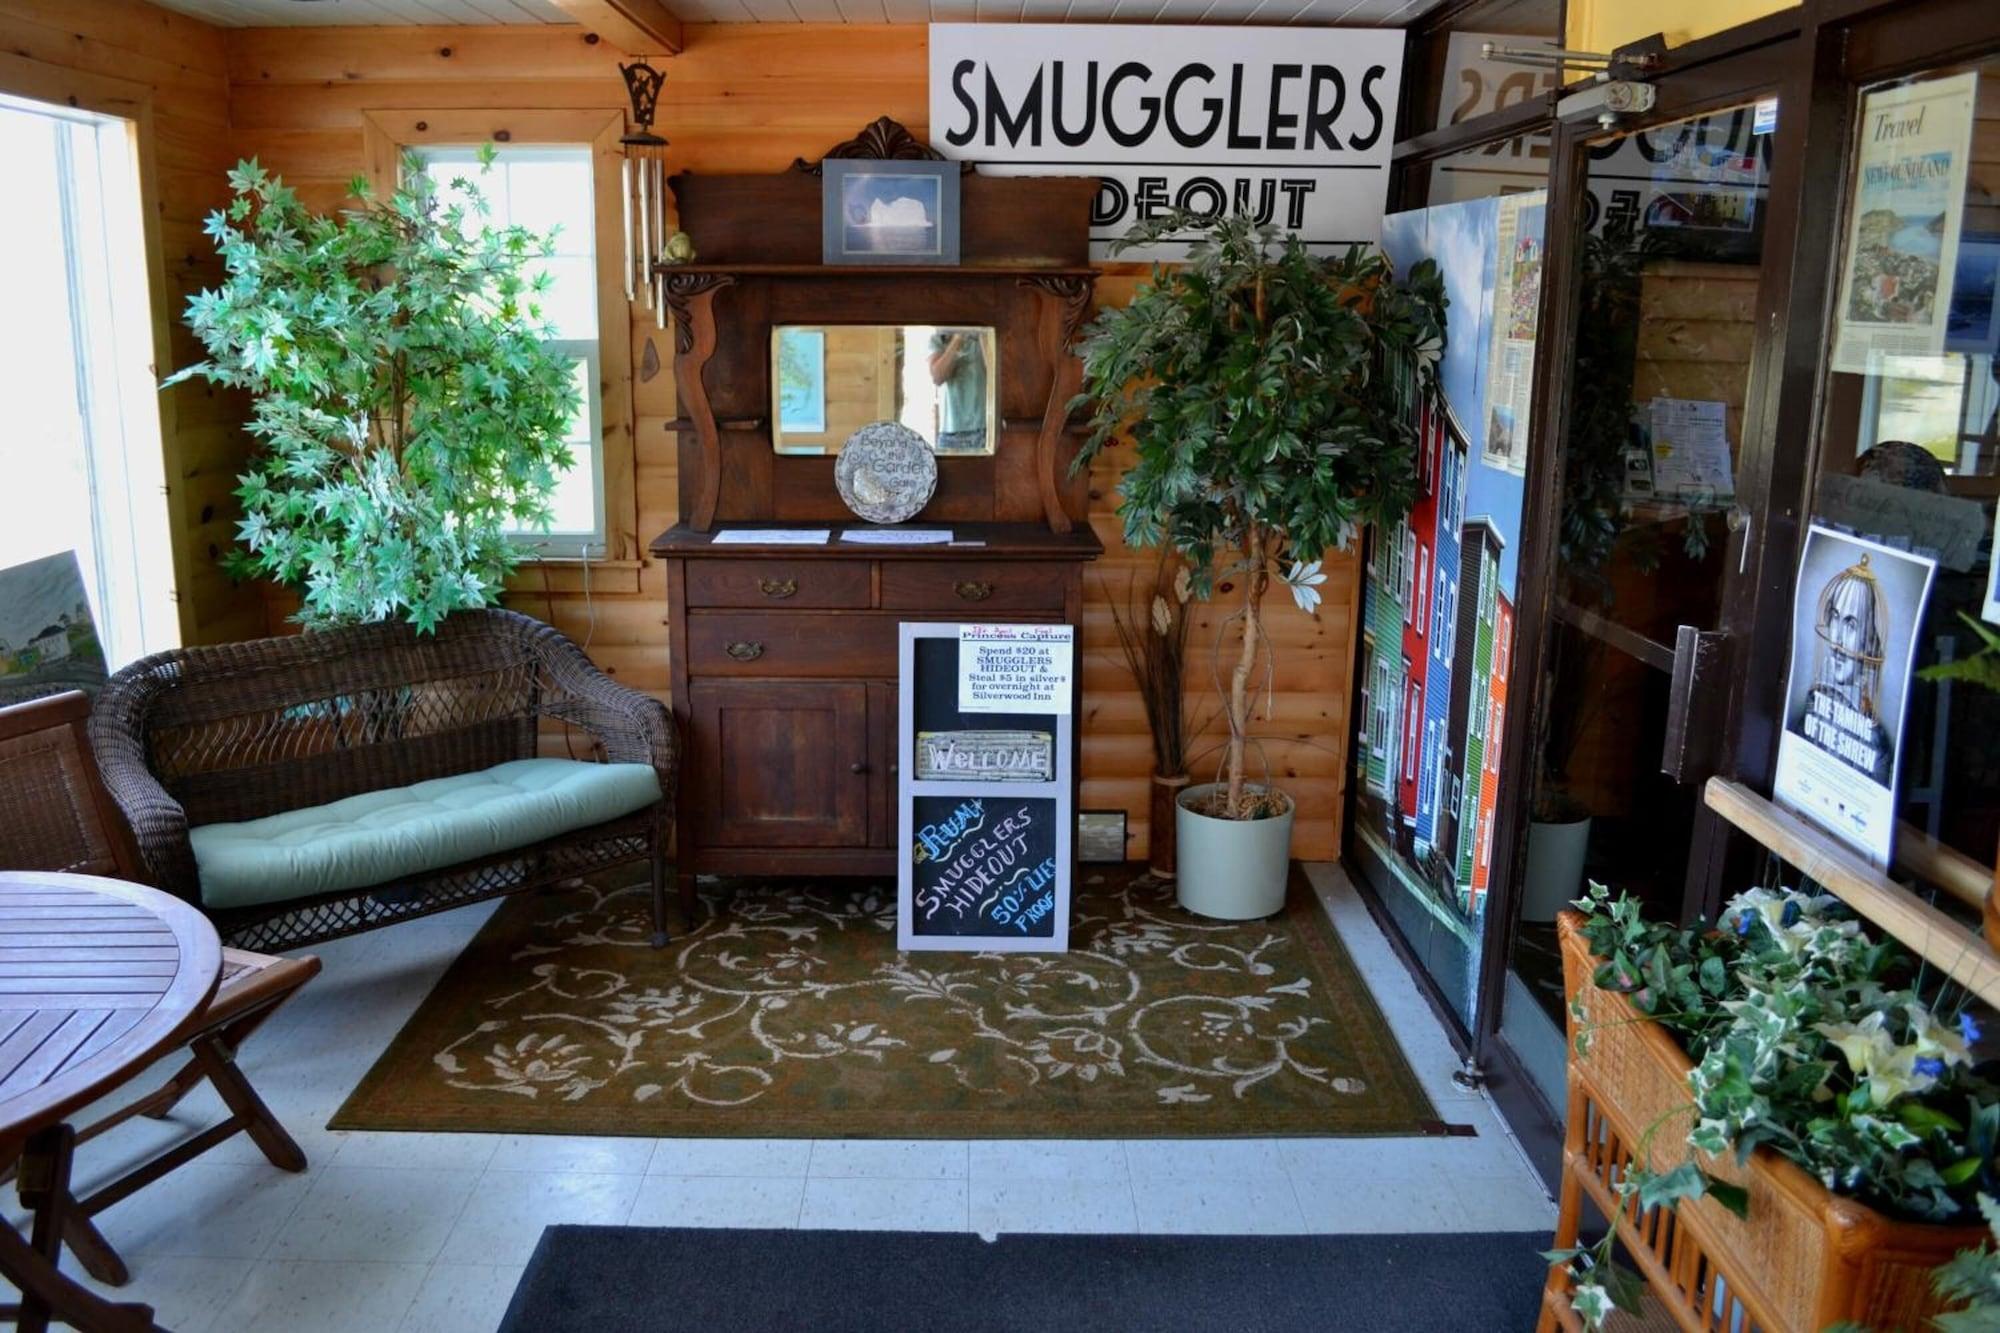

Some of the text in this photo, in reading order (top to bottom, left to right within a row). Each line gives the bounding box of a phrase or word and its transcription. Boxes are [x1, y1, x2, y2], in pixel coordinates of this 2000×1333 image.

[945, 59, 1386, 151] SMUGGLERS
[1874, 105, 1926, 142] Travel
[872, 459, 931, 475] Garden
[962, 631, 1071, 641] Princess Capture
[978, 645, 1050, 657] Spend $20 at
[976, 656, 1053, 665] SMUGGLERS
[980, 664, 1049, 673] HIDEOUT &
[968, 673, 996, 682] Steal
[999, 674, 1013, 682] $5
[1015, 674, 1026, 682] in
[1029, 674, 1059, 683] silver
[972, 682, 1055, 692] for overnight at
[972, 691, 1052, 701] Silverwood Inn
[1813, 690, 1833, 719] THE
[1804, 713, 1877, 773] OF THE SHREW
[916, 806, 1032, 920] SMUGGLERS
[945, 832, 1027, 919] HIDEOUT
[1014, 890, 1053, 932] PROOF
